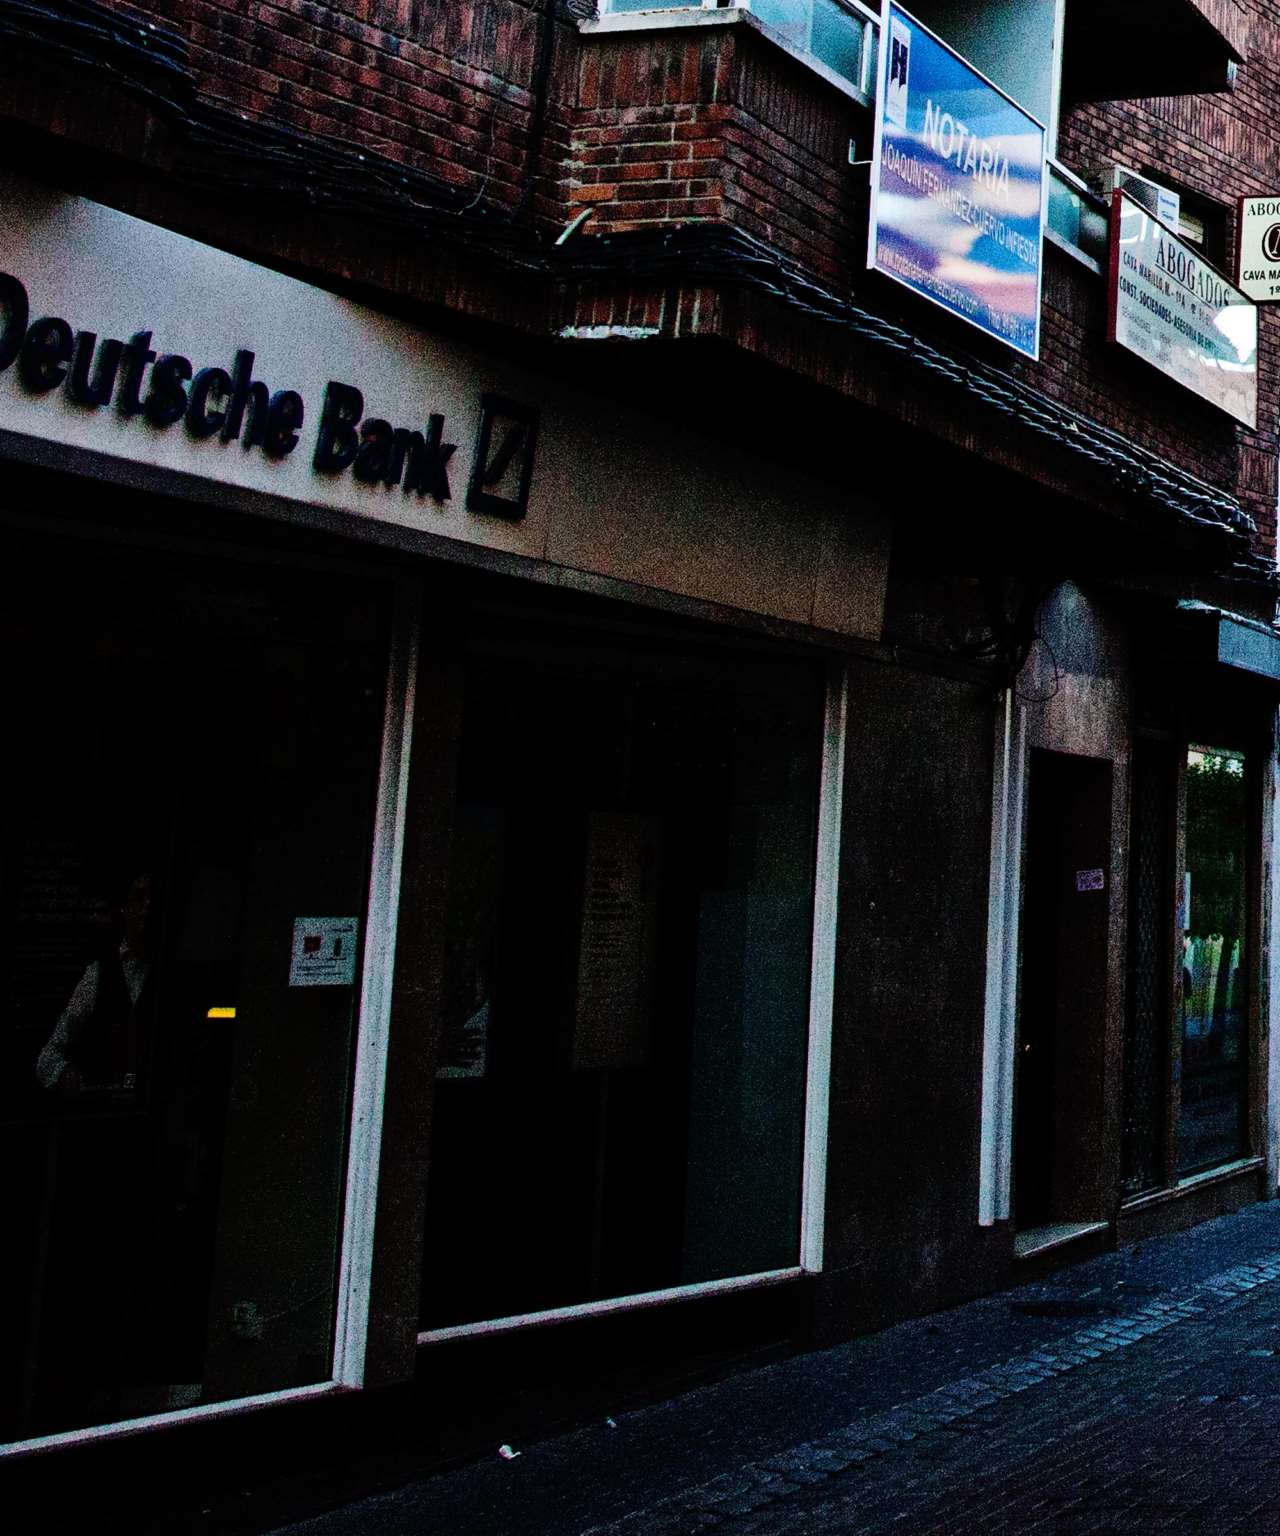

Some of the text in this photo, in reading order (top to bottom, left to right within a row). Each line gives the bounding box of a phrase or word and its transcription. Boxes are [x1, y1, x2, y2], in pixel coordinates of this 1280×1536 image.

[1156, 238, 1232, 310] ABOGADOS
[1243, 270, 1266, 281] CAVA
[313, 380, 457, 500] Bank
